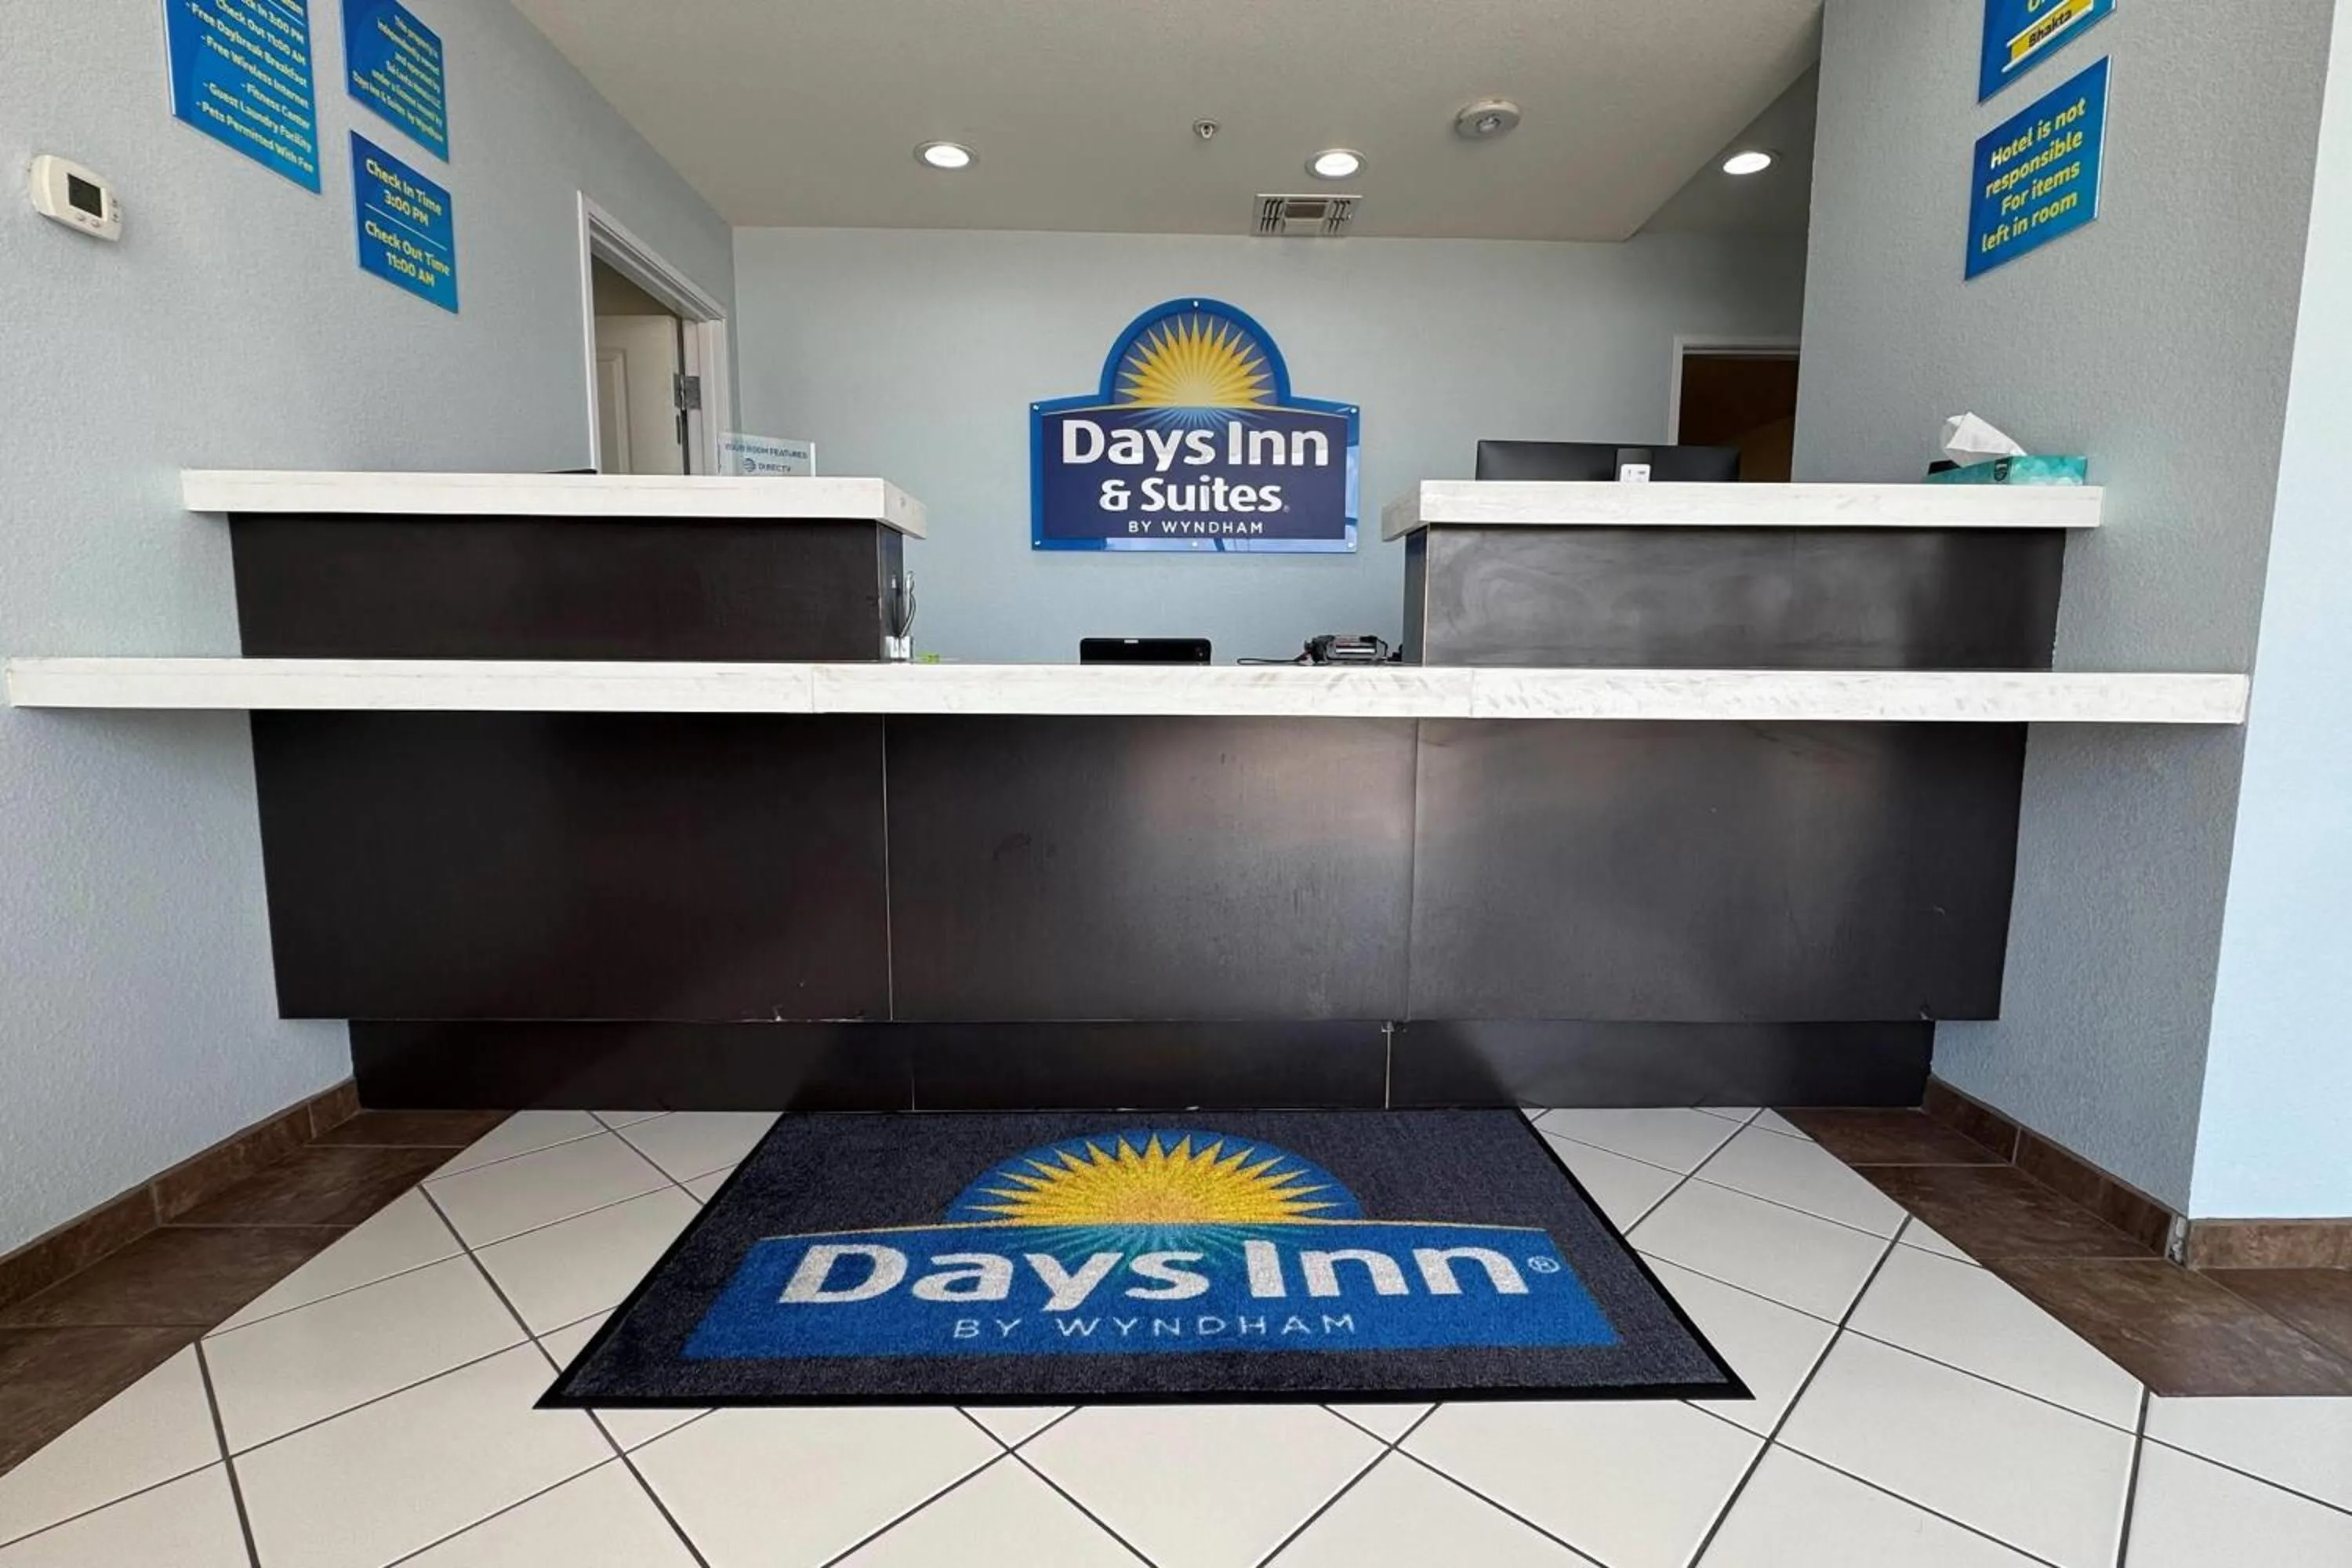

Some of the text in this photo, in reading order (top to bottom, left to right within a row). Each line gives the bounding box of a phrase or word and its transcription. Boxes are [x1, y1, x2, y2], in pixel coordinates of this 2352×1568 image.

[247, 19, 266, 38] Out
[2028, 9, 2072, 48] Bhakta
[1990, 96, 2087, 170] Hotel is not
[366, 159, 442, 216] Check In Time
[1985, 129, 2084, 199] responsible
[2001, 160, 2082, 216] For items
[384, 190, 430, 227] 3:00 PM
[1981, 191, 2078, 253] left in room
[365, 220, 452, 277] Check Out Time
[386, 252, 436, 288] 11:00 AM
[1062, 419, 1330, 472] Days Inn
[1099, 474, 1283, 513] & Suites
[1128, 520, 1264, 535] BY WYNDHAM
[779, 1244, 1210, 1311] Days
[1243, 1240, 1530, 1298] Inn
[953, 1314, 1356, 1338] BY WYNDHAM
